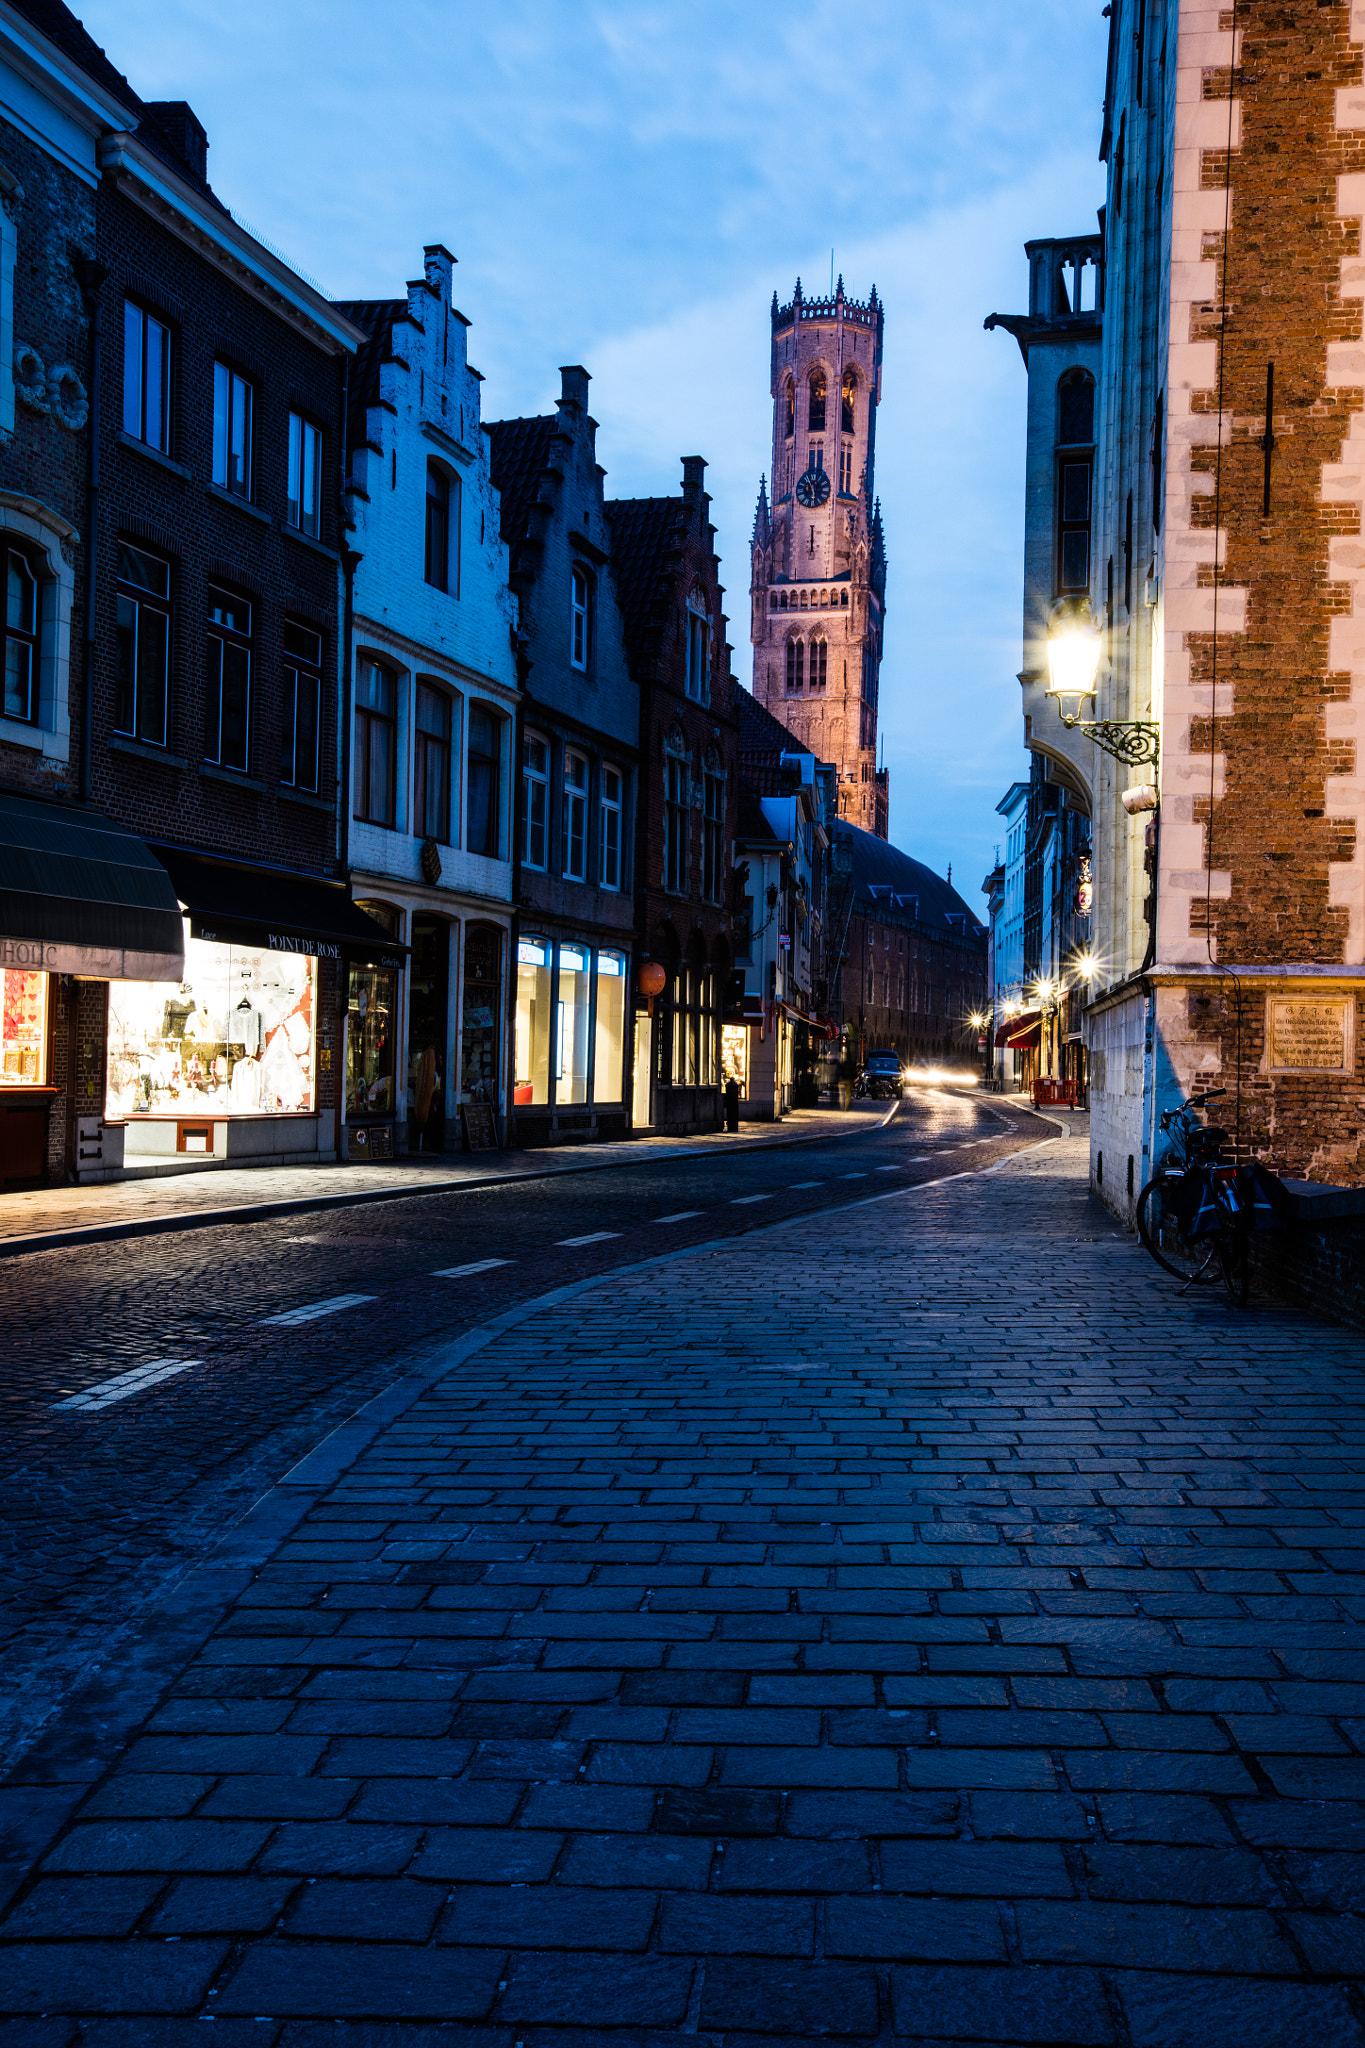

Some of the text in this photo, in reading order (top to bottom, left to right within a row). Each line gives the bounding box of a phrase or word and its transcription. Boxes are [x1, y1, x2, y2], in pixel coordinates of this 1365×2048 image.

[201, 928, 216, 940] Lace
[268, 933, 341, 959] POINT DE ROSE
[0, 942, 57, 966] HOLIC
